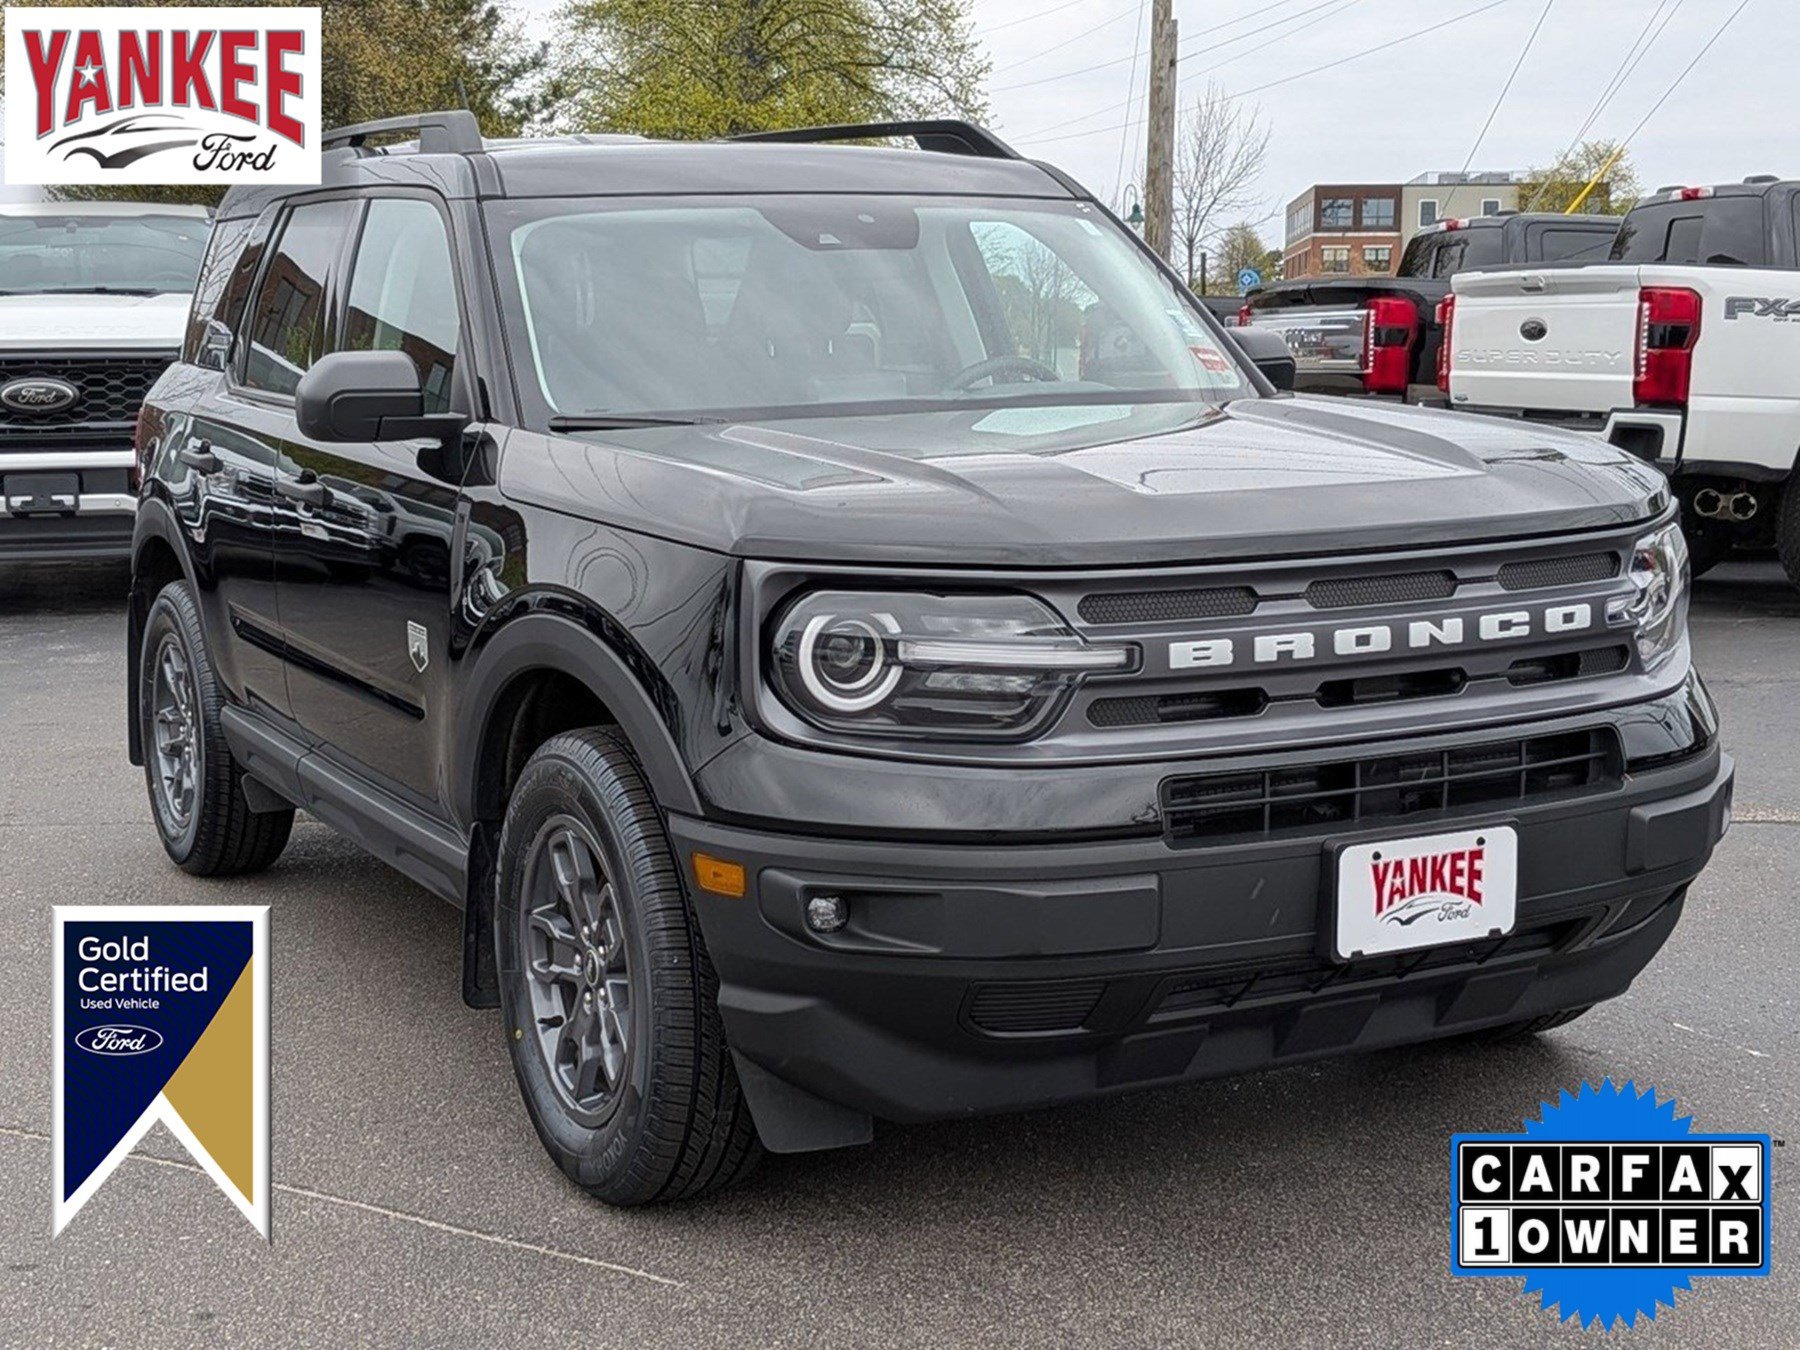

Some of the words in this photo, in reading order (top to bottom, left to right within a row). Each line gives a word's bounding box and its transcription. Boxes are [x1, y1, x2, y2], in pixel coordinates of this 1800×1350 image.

[1457, 349, 1539, 364] SUPER
[1545, 350, 1622, 365] DUTY
[17, 387, 57, 404] Ford
[1168, 603, 1592, 670] BRONCO
[1371, 848, 1485, 917] YANKEE
[1437, 901, 1472, 922] Ford
